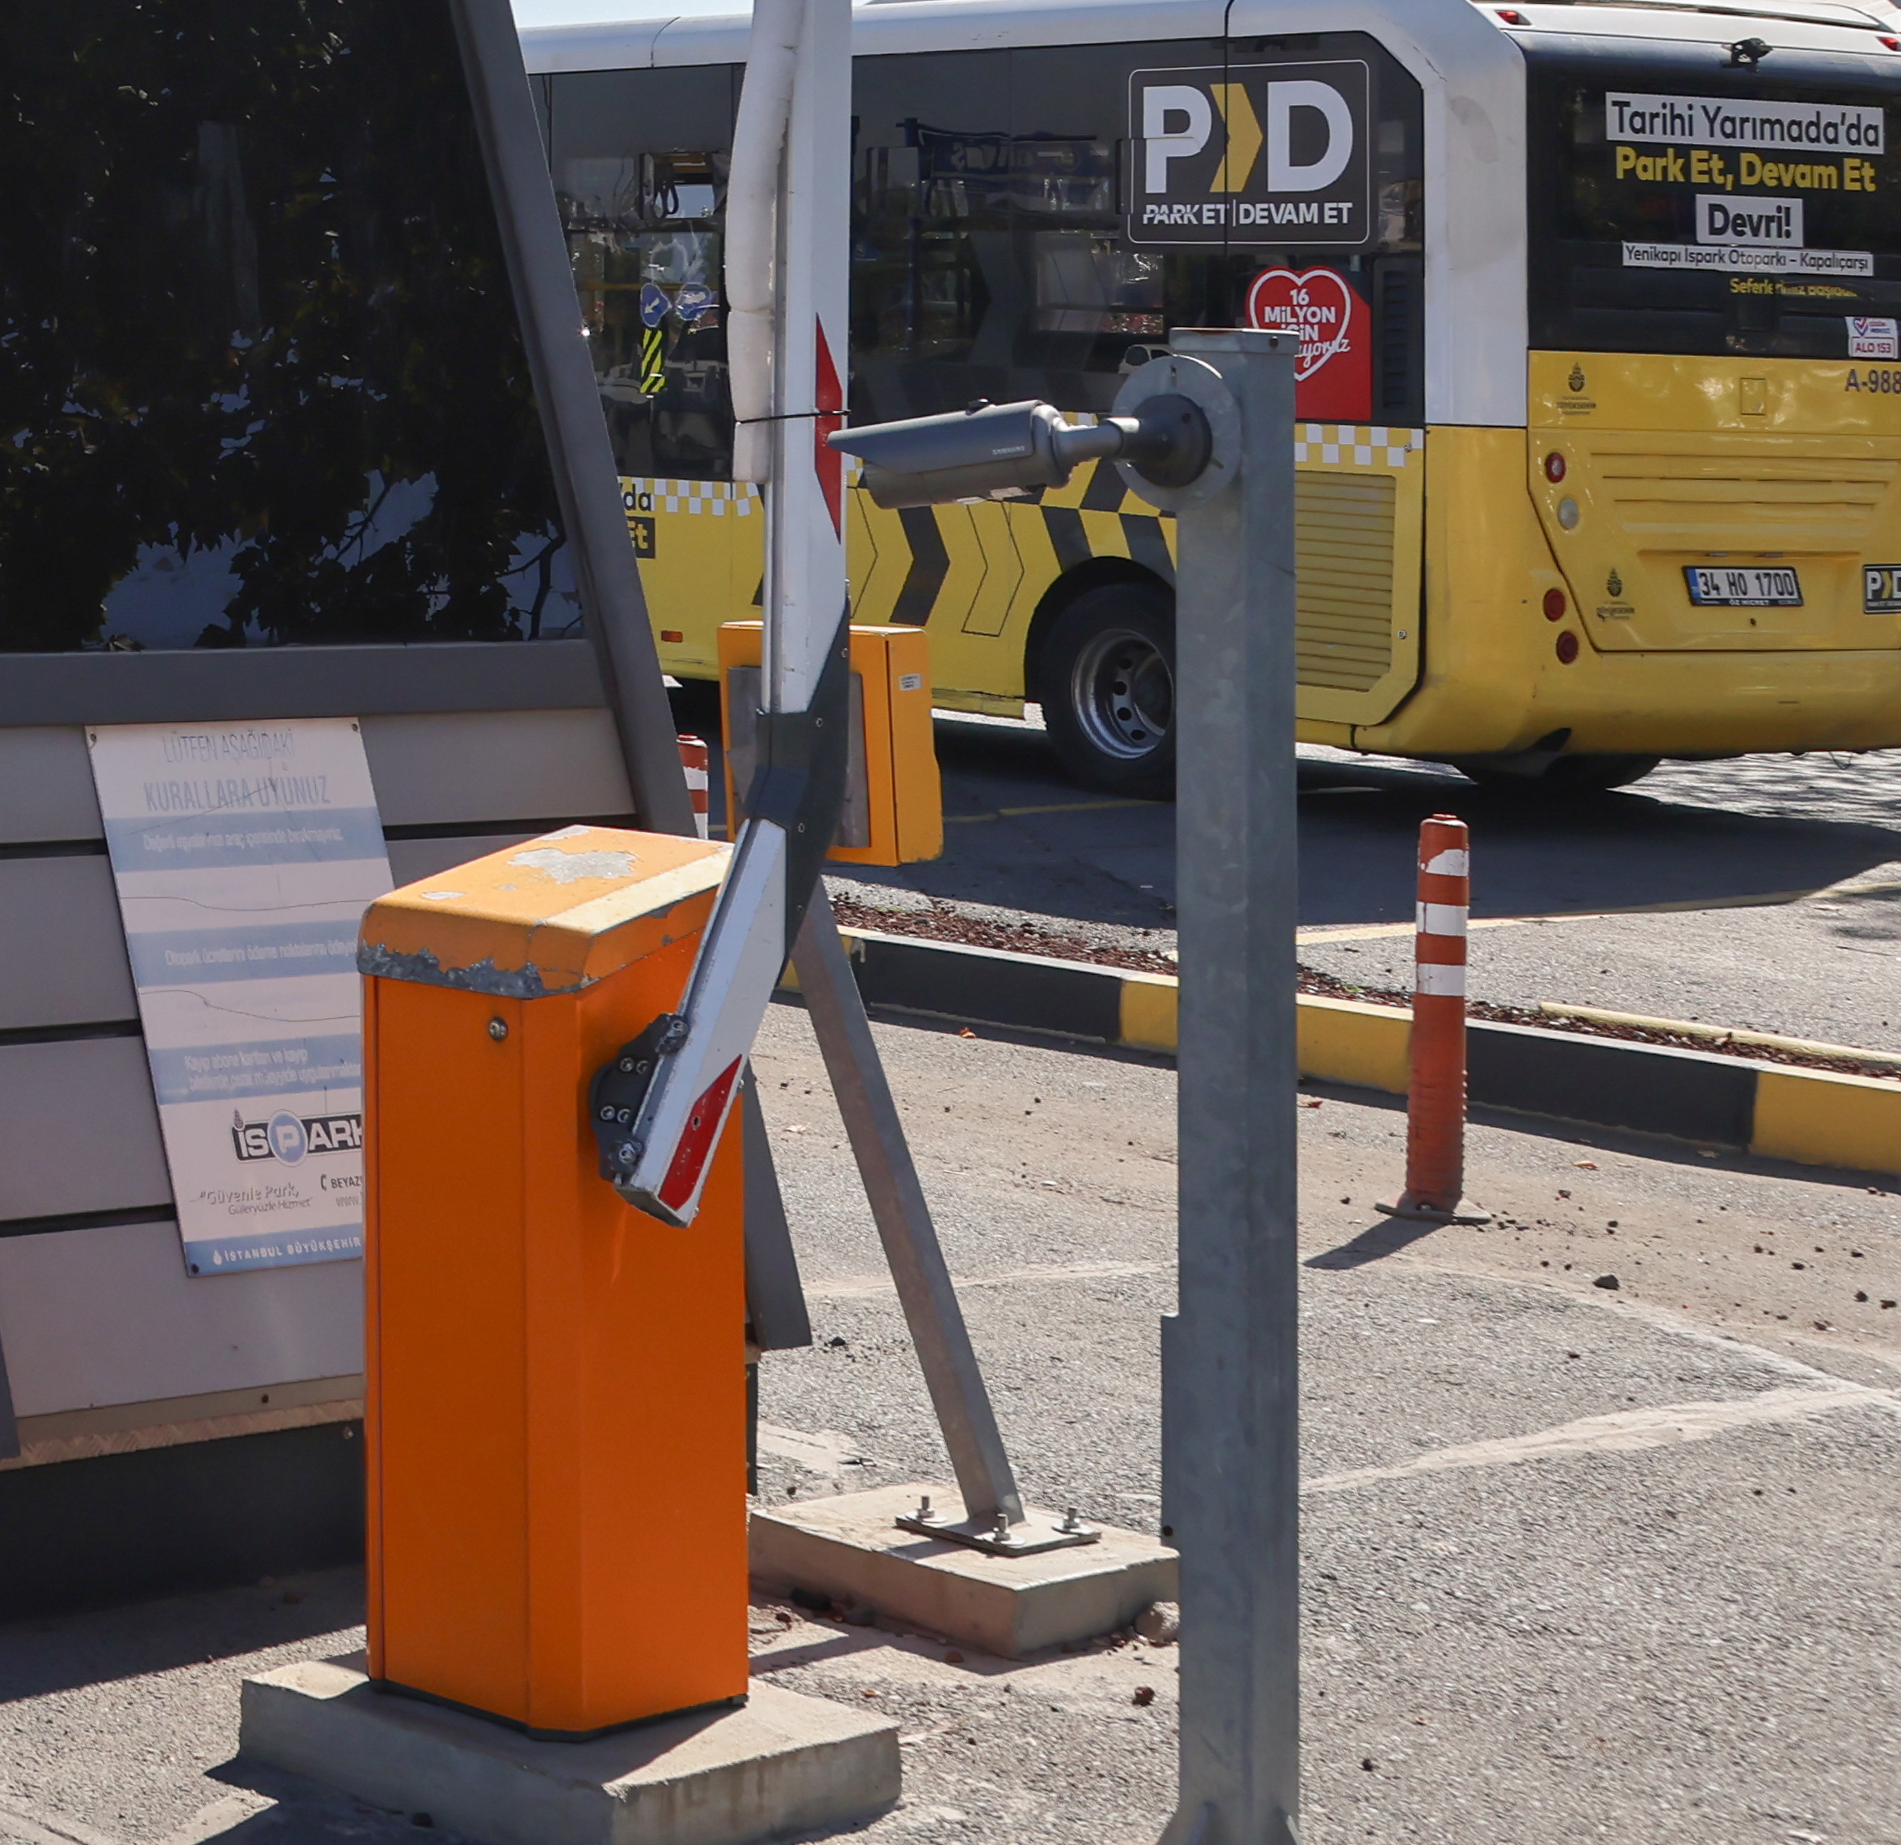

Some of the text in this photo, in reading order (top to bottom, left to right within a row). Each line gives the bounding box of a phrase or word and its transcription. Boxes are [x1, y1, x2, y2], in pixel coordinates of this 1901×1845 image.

[1611, 100, 1879, 147] Tarihi Yarımada'da
[1616, 146, 1877, 193] Park Et, Devam Et
[1142, 202, 1352, 225] PARK ET DEVAM ET
[1707, 202, 1792, 239] Devri!
[1625, 246, 1681, 265] Yenikapı
[1728, 250, 1787, 268] Otoparkı
[1800, 253, 1868, 272] Kapalıçarşı
[1290, 288, 1309, 305] 16
[1855, 343, 1891, 353] ALO 153
[1698, 572, 1720, 596] 34
[1755, 572, 1795, 596] 1700
[163, 728, 296, 764] LÜTFEN AŞAĞIDAKİ
[144, 775, 331, 811] KURALLARA UYUNUZ
[224, 1237, 361, 1262] İSTANBUL BÜYÜKŞEHİR
